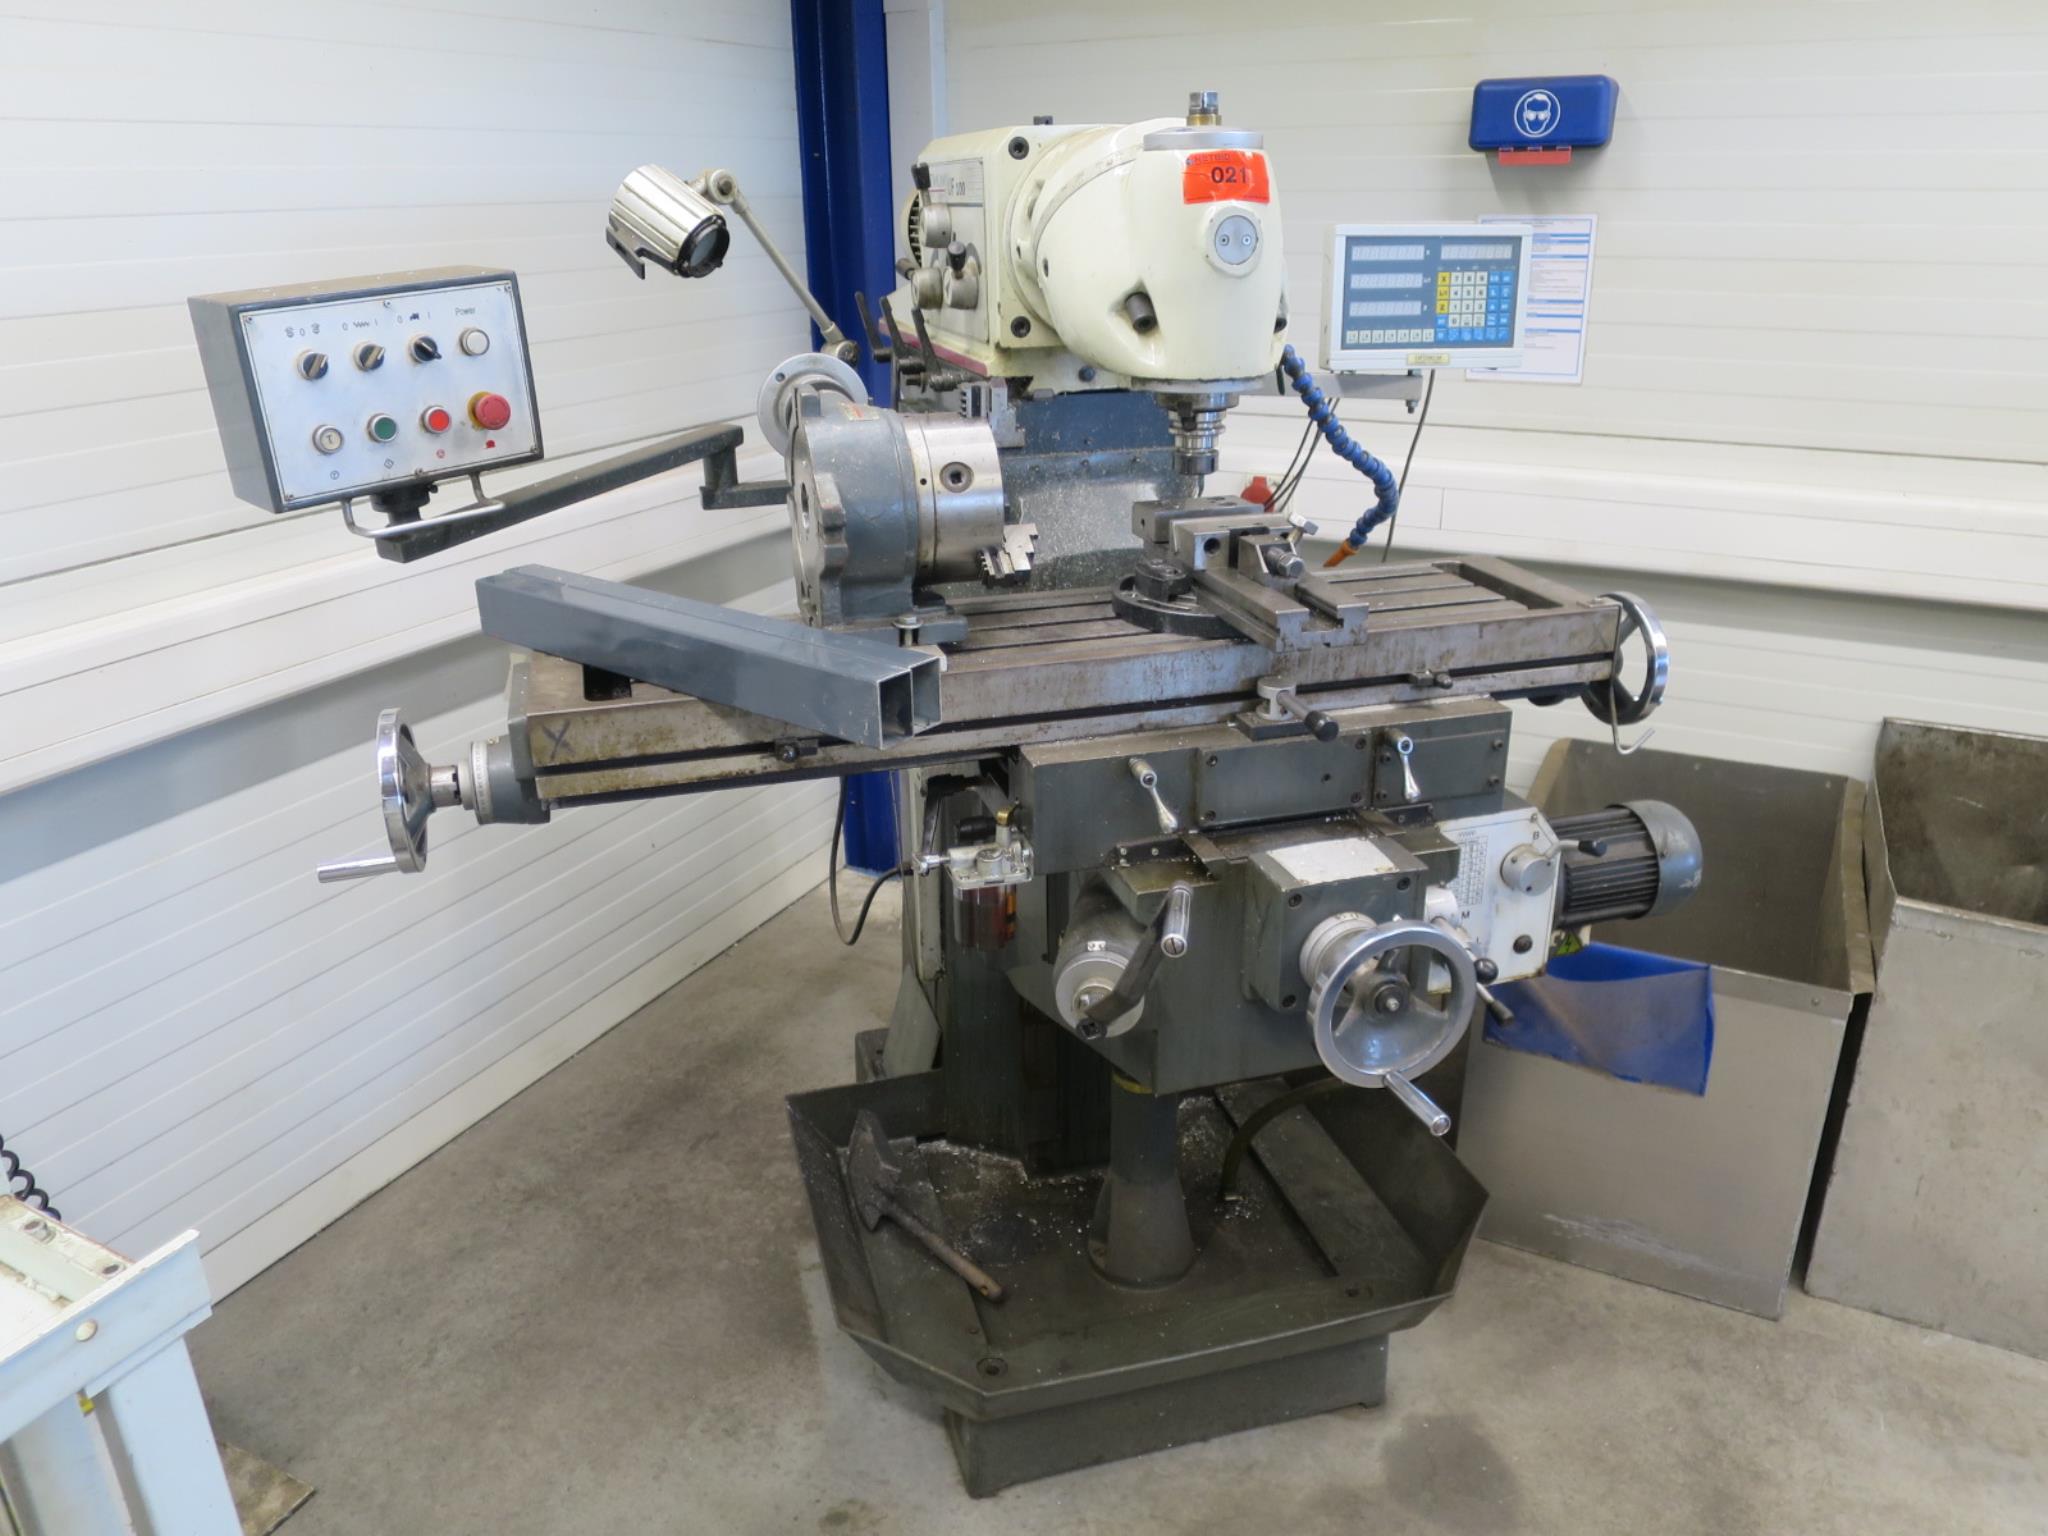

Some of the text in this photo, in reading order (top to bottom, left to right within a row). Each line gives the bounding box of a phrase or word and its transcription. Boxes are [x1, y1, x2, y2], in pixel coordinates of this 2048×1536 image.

[1211, 166, 1246, 184] 021
[455, 307, 476, 316] Power
[1461, 911, 1471, 919] M
